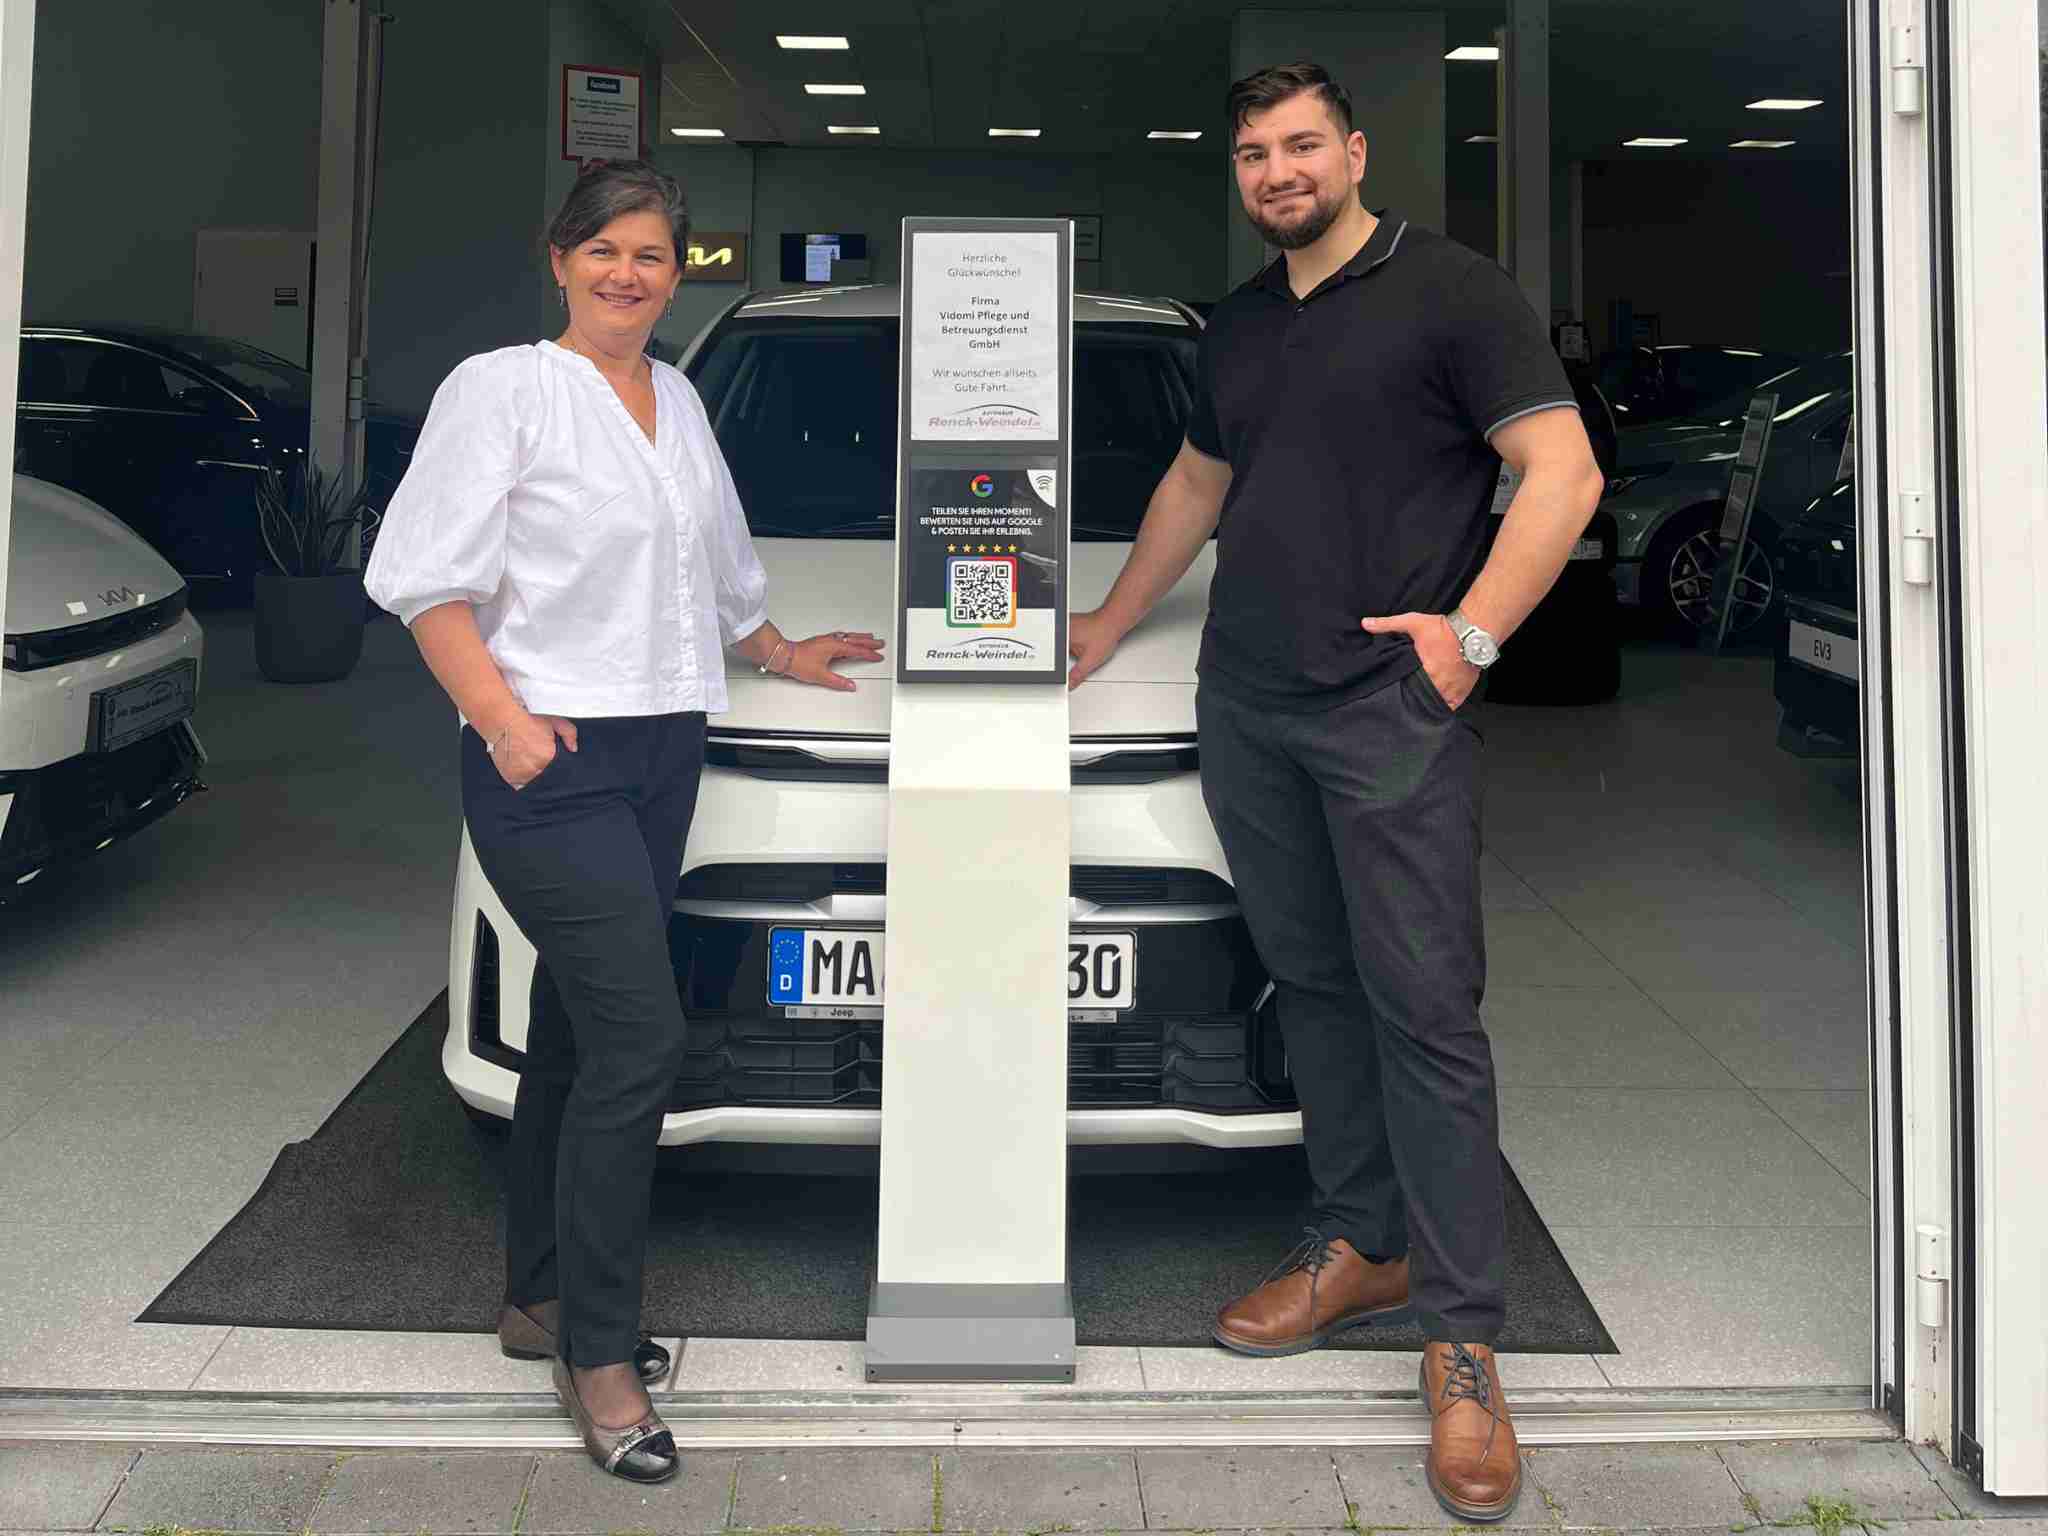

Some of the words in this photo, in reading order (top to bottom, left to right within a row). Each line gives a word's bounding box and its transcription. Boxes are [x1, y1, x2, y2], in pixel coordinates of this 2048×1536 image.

[962, 253, 1008, 263] Herzliche
[971, 297, 1000, 306] Firma
[939, 311, 975, 320] Vidomi
[977, 311, 1008, 322] Pflege
[1010, 311, 1030, 320] und
[941, 325, 1029, 336] Betreuungsdienst
[968, 340, 1000, 349] GmbH
[932, 367, 951, 377] Wir
[952, 367, 1001, 377] wünschen
[954, 383, 978, 392] Gute
[928, 416, 1033, 427] Renck-Weindel
[931, 507, 957, 515] TEILEN
[958, 507, 969, 515] SIE
[970, 507, 993, 515] IHREN
[920, 517, 961, 526] BEWERTEN
[962, 517, 973, 526] SIE
[974, 517, 991, 526] UNS
[991, 517, 1007, 526] AUF
[1007, 517, 1042, 526] GOOGLE
[931, 527, 937, 536] &
[938, 527, 969, 536] POSTEN
[969, 527, 981, 536] SIE
[982, 527, 995, 536] IHR
[926, 649, 1028, 660] Renck-Weindel
[1814, 639, 1832, 660] EV3
[811, 939, 876, 996] MA
[779, 974, 792, 991] D
[829, 1007, 855, 1018] Jeep
